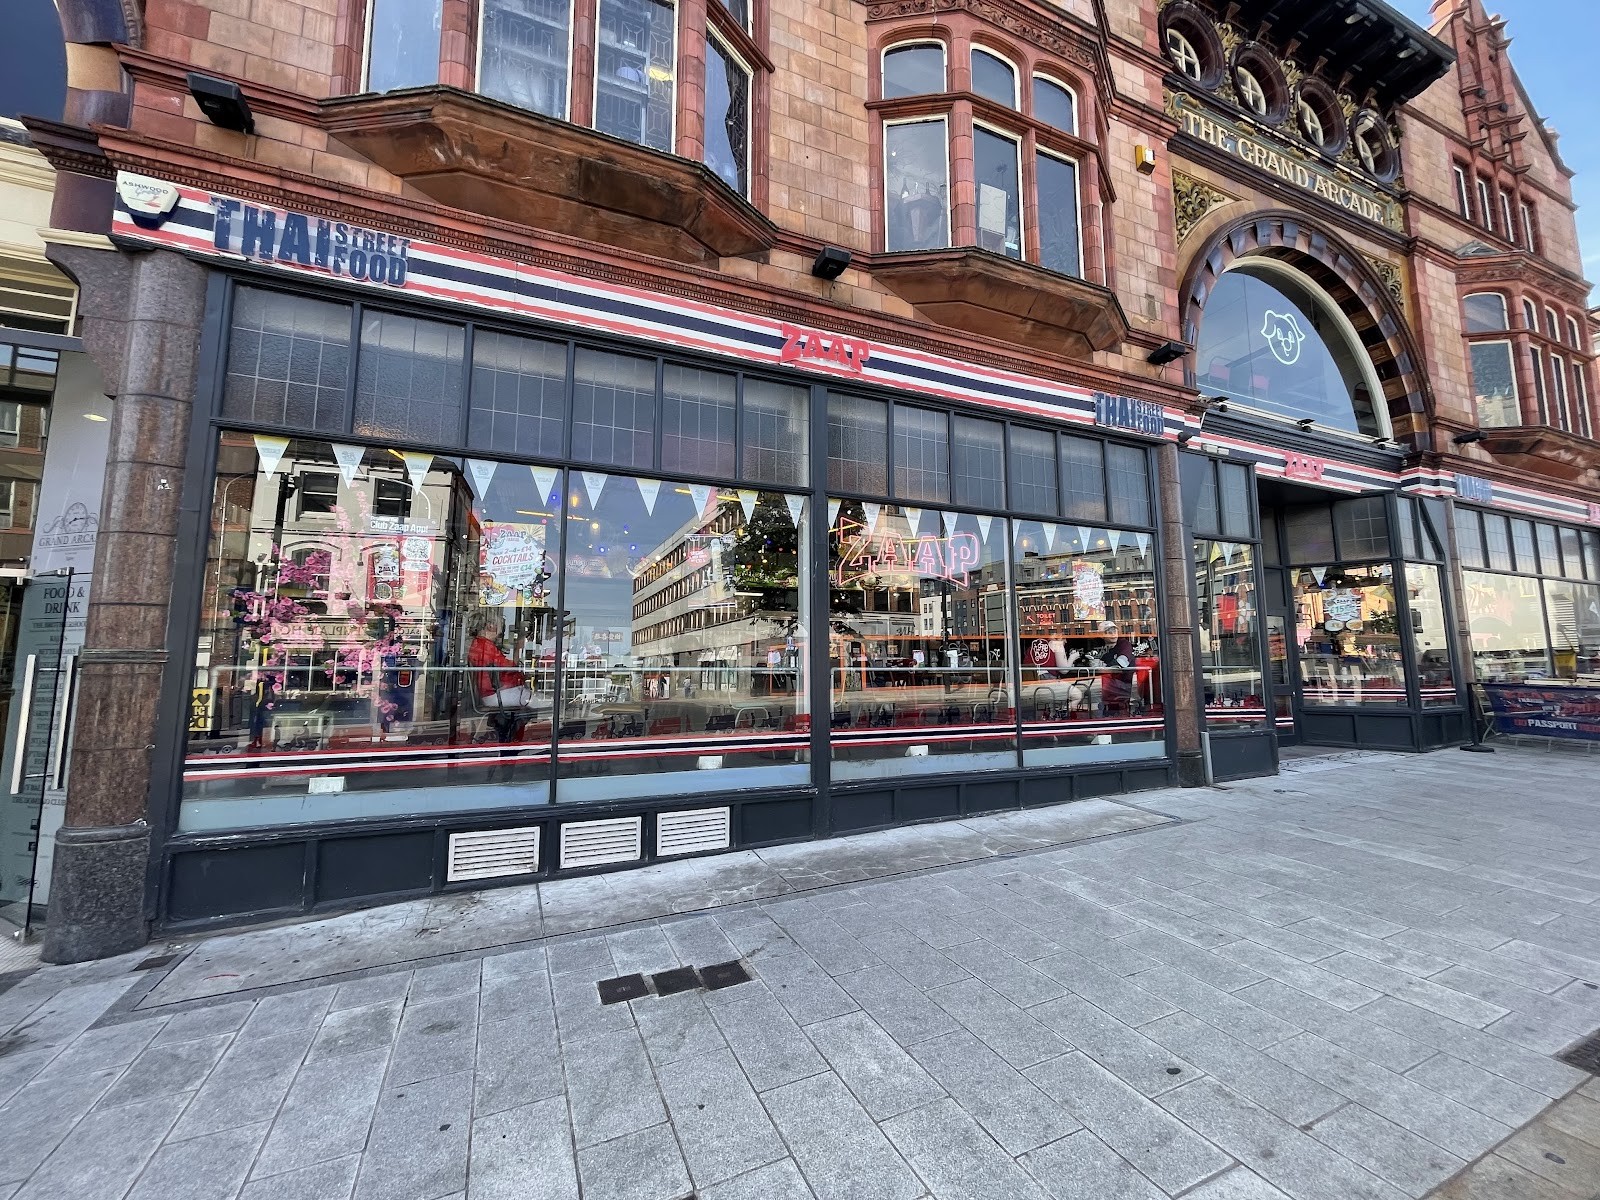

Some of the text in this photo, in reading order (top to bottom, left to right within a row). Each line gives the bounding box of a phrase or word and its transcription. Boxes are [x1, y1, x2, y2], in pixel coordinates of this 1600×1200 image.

[1182, 109, 1384, 225] THE GRAND ARCADE
[122, 181, 169, 195] ASHWOOD
[210, 197, 331, 268] THAI
[335, 222, 410, 258] STREET
[333, 245, 407, 286] FOOD
[781, 321, 870, 374] ZAAP
[1093, 391, 1137, 429] THAI
[1136, 399, 1164, 418] STREET
[1137, 414, 1164, 435] FOOD
[1285, 451, 1324, 480] ZAAP
[370, 520, 388, 530] Club
[388, 521, 409, 532] Zaap
[410, 523, 429, 535] App!
[500, 529, 527, 539] ZAAP
[38, 534, 95, 547] GRAND ARCA
[492, 552, 534, 565] COCKTAILS
[838, 516, 980, 587] ZAAP
[44, 587, 85, 599] FOOD &
[45, 602, 80, 614] DRINK
[1527, 719, 1578, 731] PASSPORT
